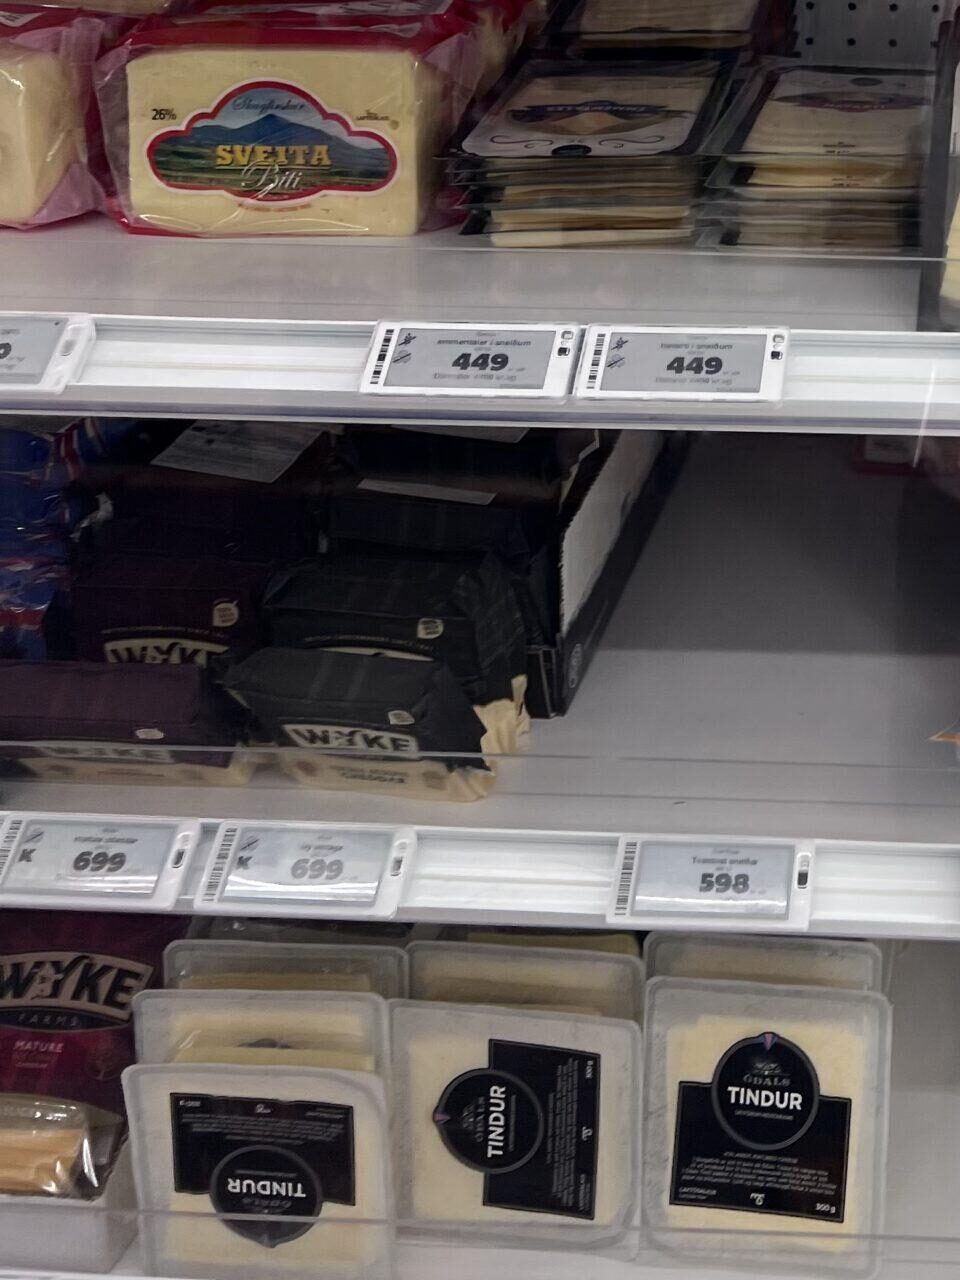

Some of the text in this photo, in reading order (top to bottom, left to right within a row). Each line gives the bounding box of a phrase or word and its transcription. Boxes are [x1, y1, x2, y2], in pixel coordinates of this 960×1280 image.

[452, 352, 509, 371] 449
[666, 356, 723, 375] 449
[292, 727, 412, 754] WYKE
[73, 851, 127, 872] 699
[290, 858, 344, 880] 699
[699, 873, 750, 894] 598
[0, 955, 142, 1011] WYKE
[13, 1040, 65, 1053] MATURE
[727, 1086, 803, 1111] TINDUR
[487, 1085, 507, 1159] TINDUR
[227, 1178, 306, 1198] TINDUR
